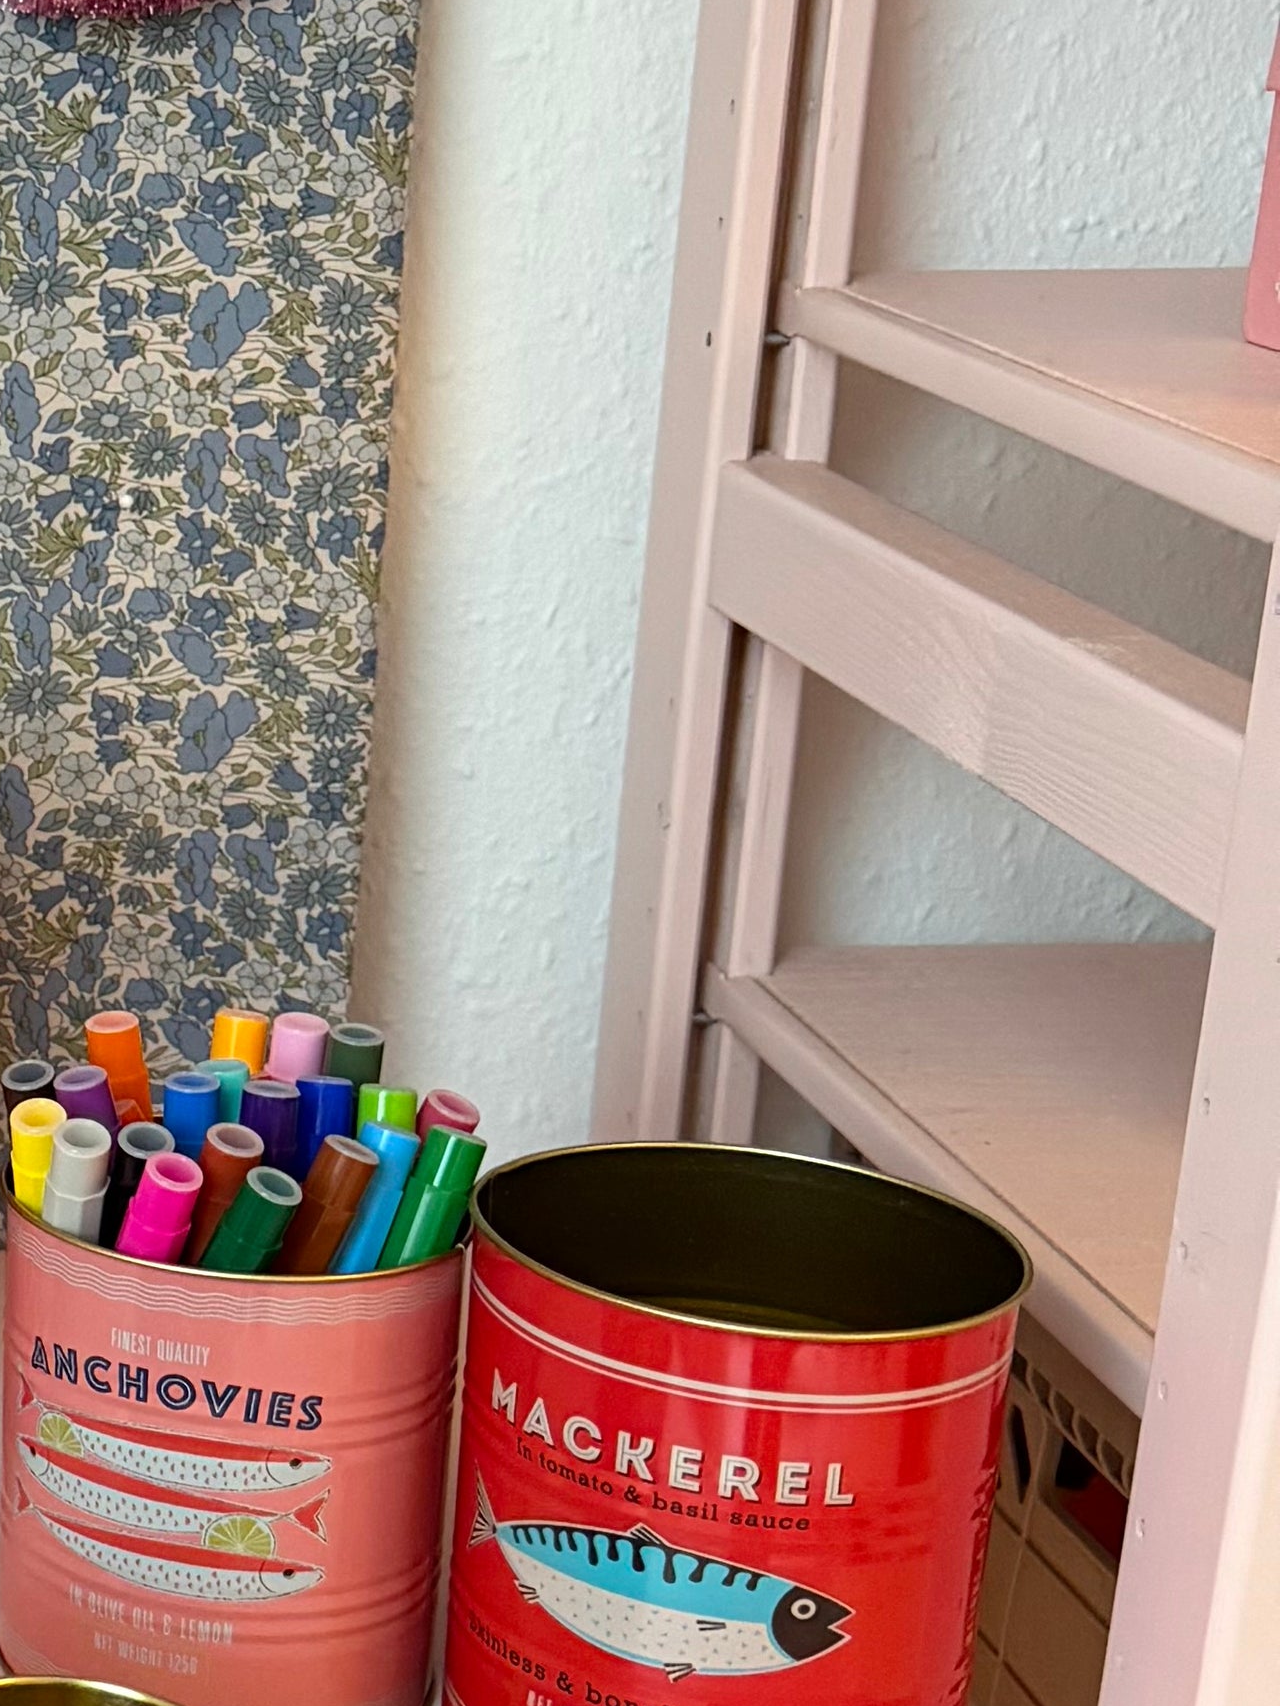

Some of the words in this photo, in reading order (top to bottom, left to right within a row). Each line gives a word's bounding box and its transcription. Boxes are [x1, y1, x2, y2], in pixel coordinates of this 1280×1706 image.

[110, 1327, 151, 1356] FINEST
[156, 1339, 211, 1367] QUALITY
[31, 1336, 323, 1431] ANCHOVIES
[490, 1367, 856, 1508] MACKEREL
[538, 1452, 614, 1496] tomato
[623, 1484, 642, 1505] &
[651, 1492, 719, 1523] basil
[729, 1507, 811, 1532] sauce
[88, 1592, 126, 1624] OLIVE
[132, 1607, 155, 1633] OIL
[180, 1617, 233, 1645] LEMON
[556, 1671, 574, 1695] &
